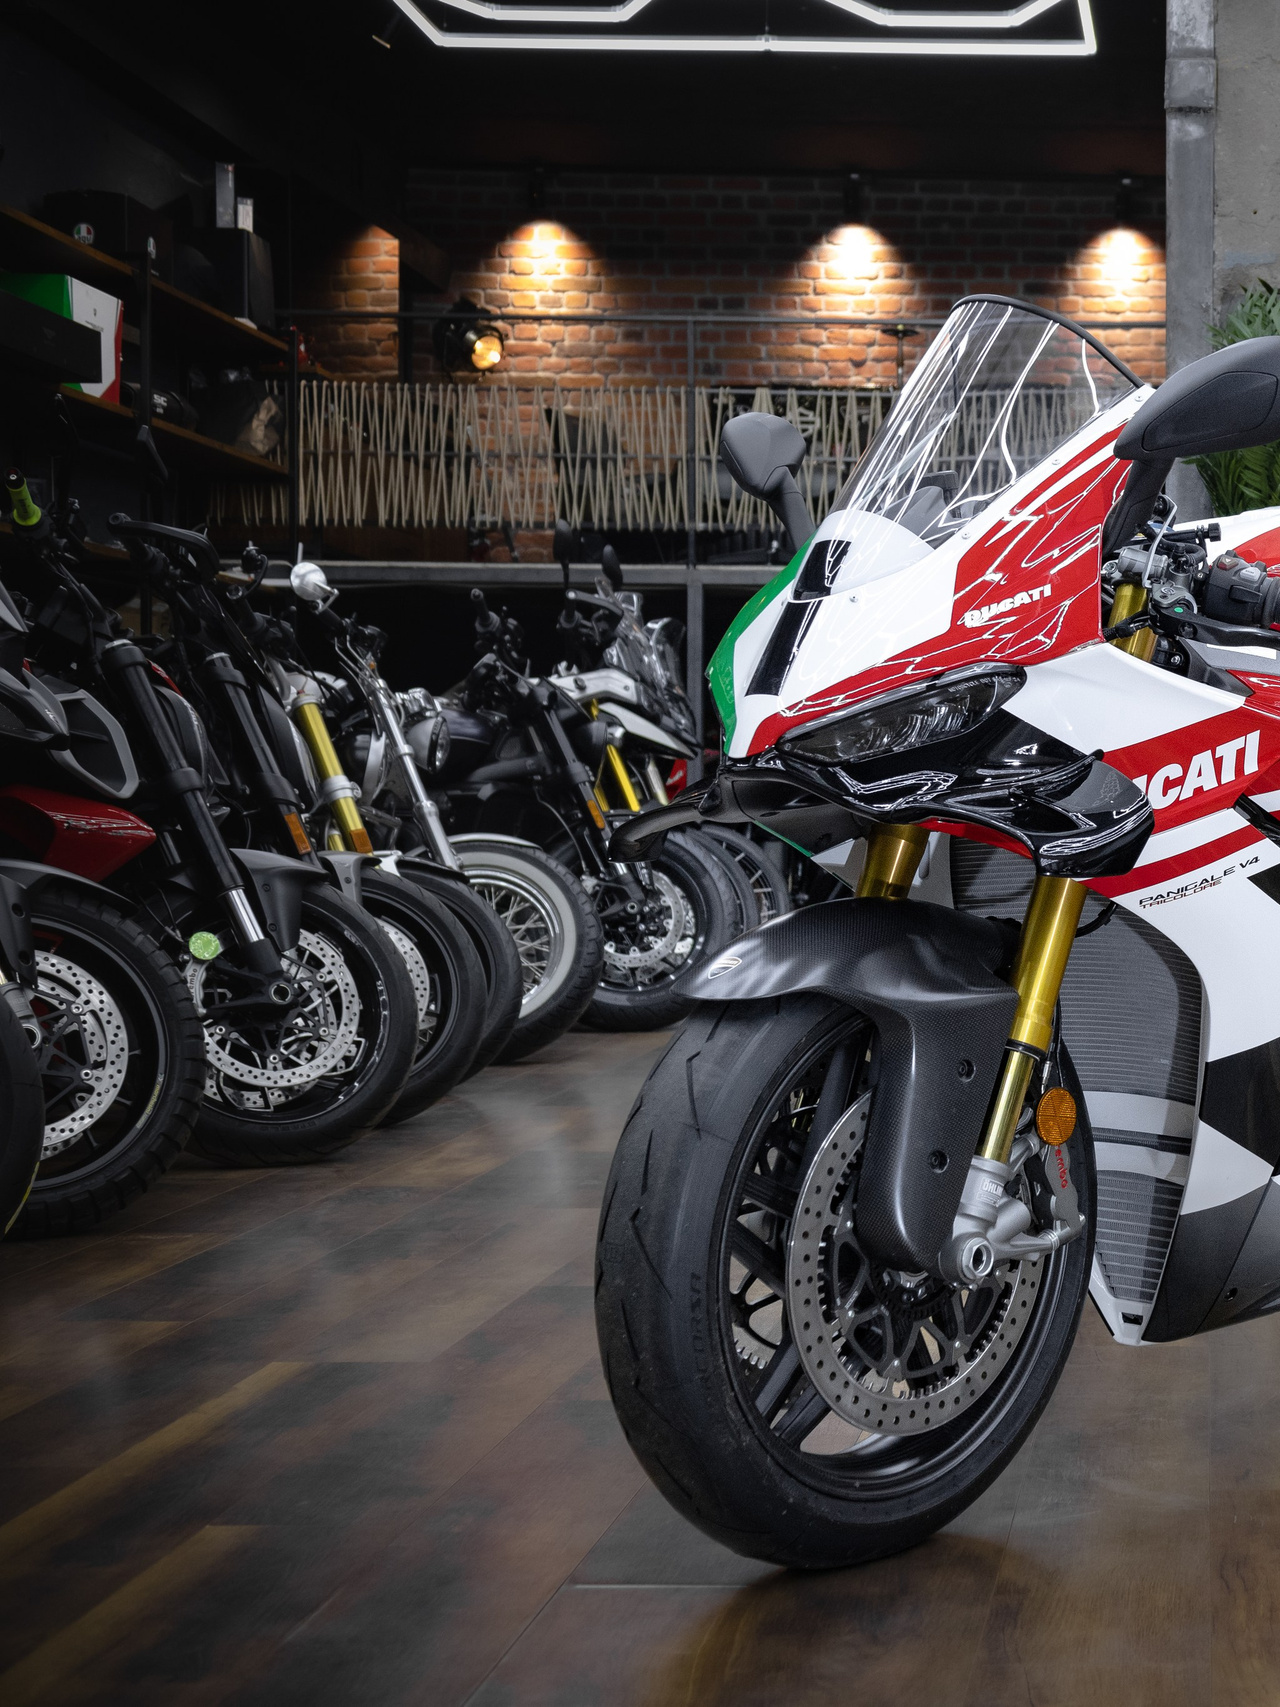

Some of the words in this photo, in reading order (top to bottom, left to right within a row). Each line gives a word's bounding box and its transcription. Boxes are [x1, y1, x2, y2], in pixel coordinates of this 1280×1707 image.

[964, 583, 1052, 623] DUCATI
[1132, 729, 1261, 810] CATI
[1139, 865, 1236, 905] PANIGALE
[1239, 856, 1260, 869] V4
[1139, 878, 1222, 909] TRICOLORE
[1054, 1145, 1069, 1189] embo
